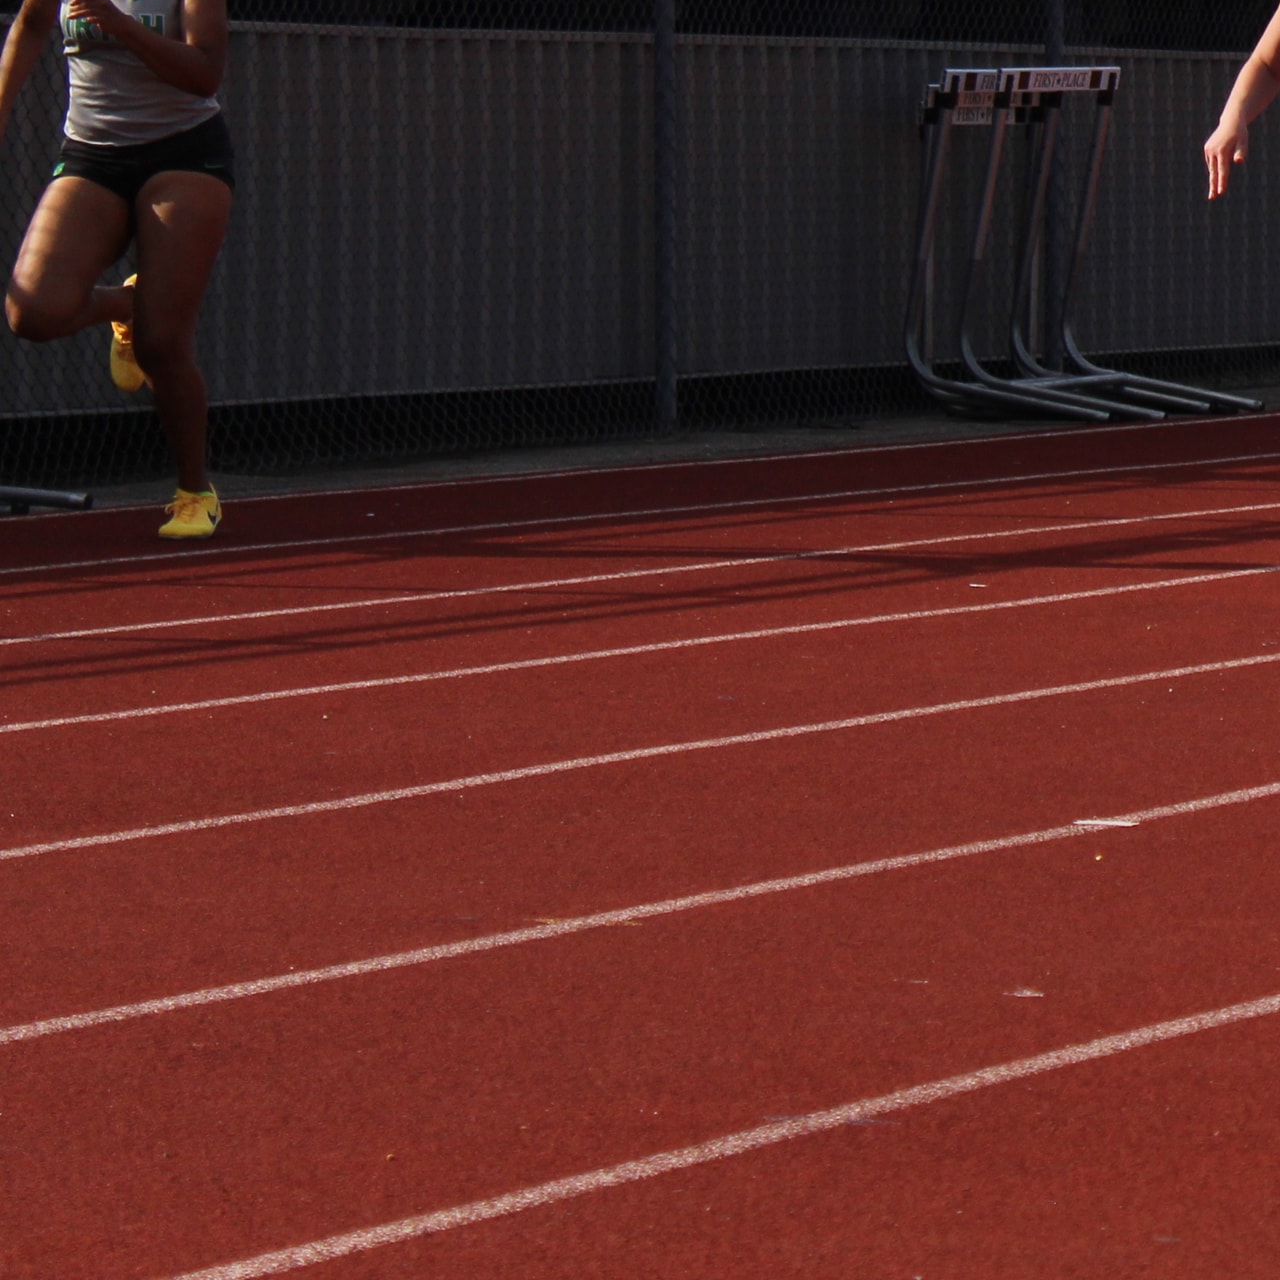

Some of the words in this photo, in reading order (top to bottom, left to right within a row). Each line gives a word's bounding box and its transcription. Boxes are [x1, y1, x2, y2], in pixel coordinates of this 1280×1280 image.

[980, 74, 996, 90] FIR
[1034, 73, 1057, 89] FIRST
[1060, 71, 1088, 88] PLACE
